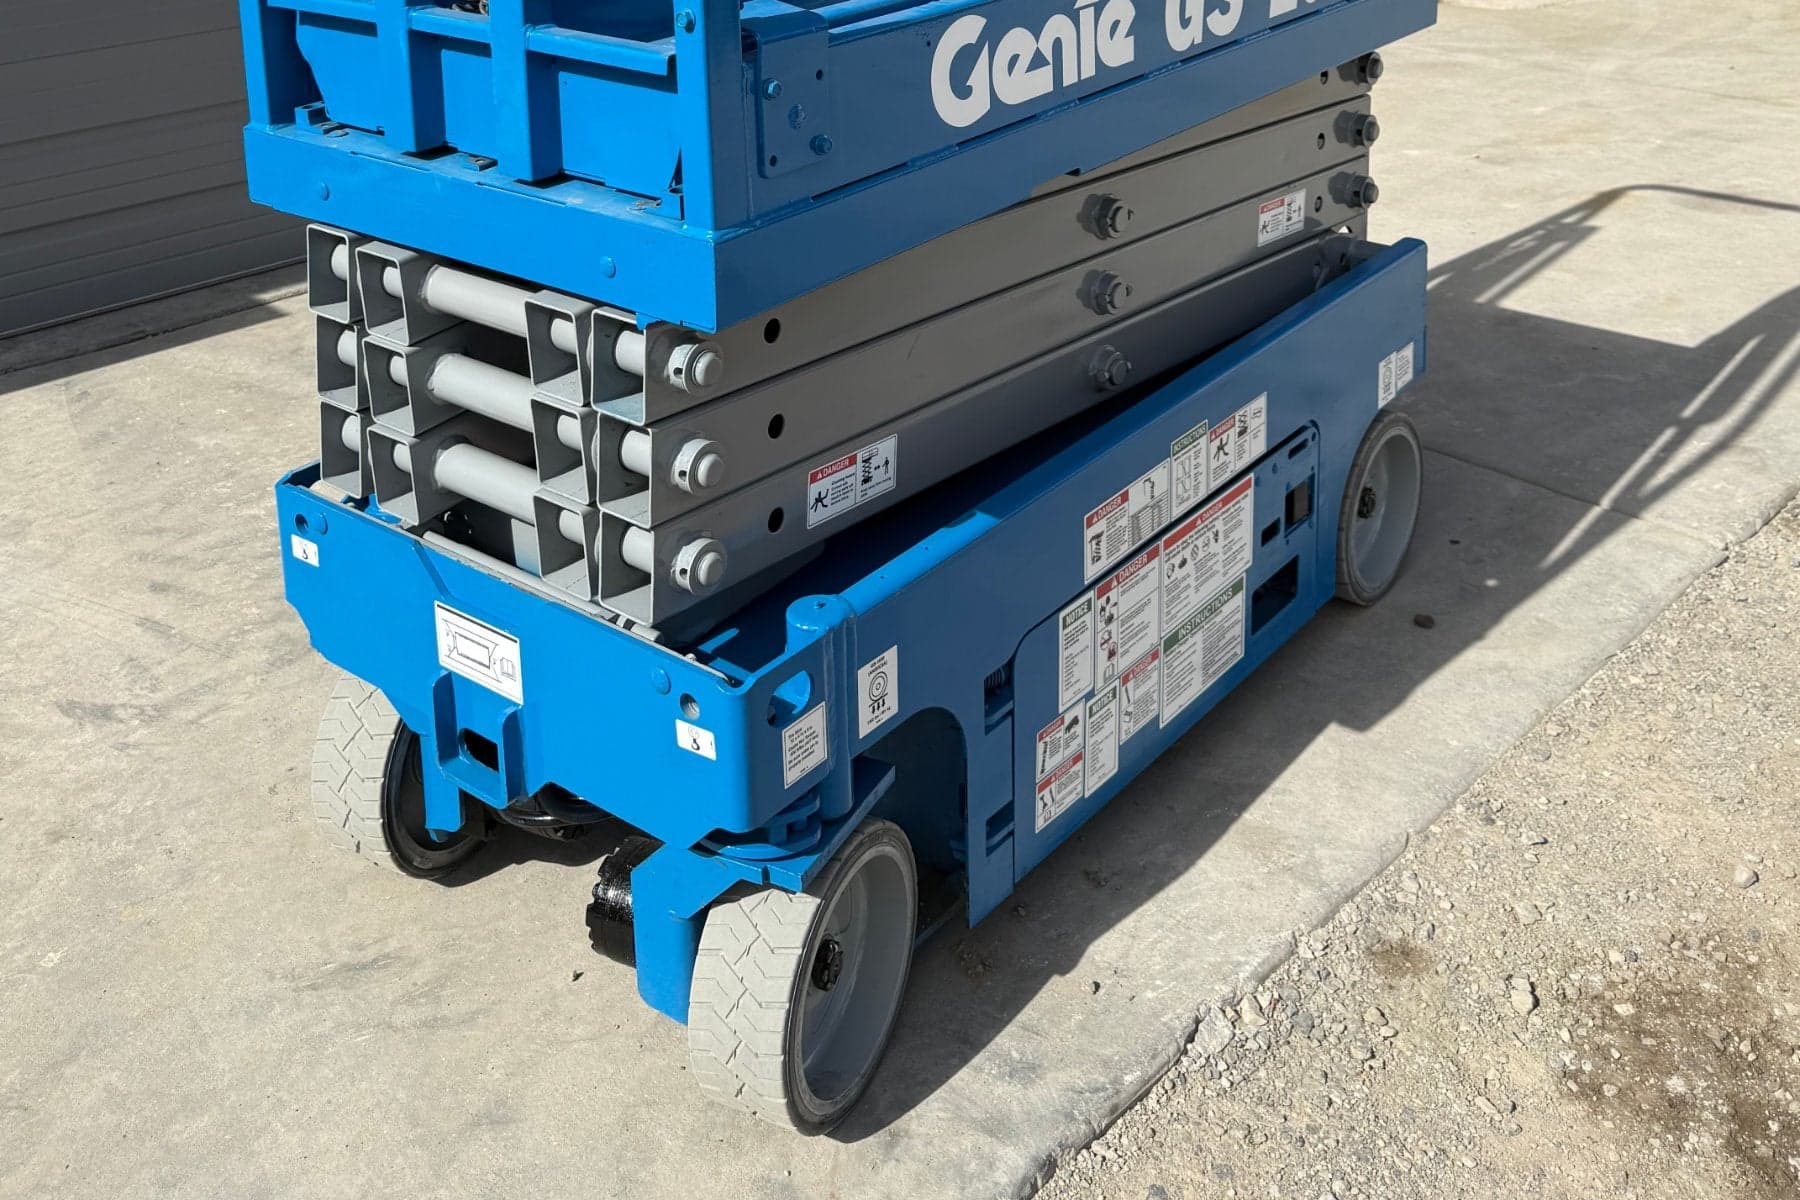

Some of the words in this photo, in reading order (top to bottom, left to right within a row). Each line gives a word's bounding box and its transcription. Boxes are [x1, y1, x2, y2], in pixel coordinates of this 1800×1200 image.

[823, 458, 849, 477] DANGER
[1099, 497, 1122, 520] DANGER
[1119, 554, 1148, 584] DANGER
[1066, 601, 1089, 624] NOTICE
[1178, 588, 1233, 639] INSTRUCTIONS
